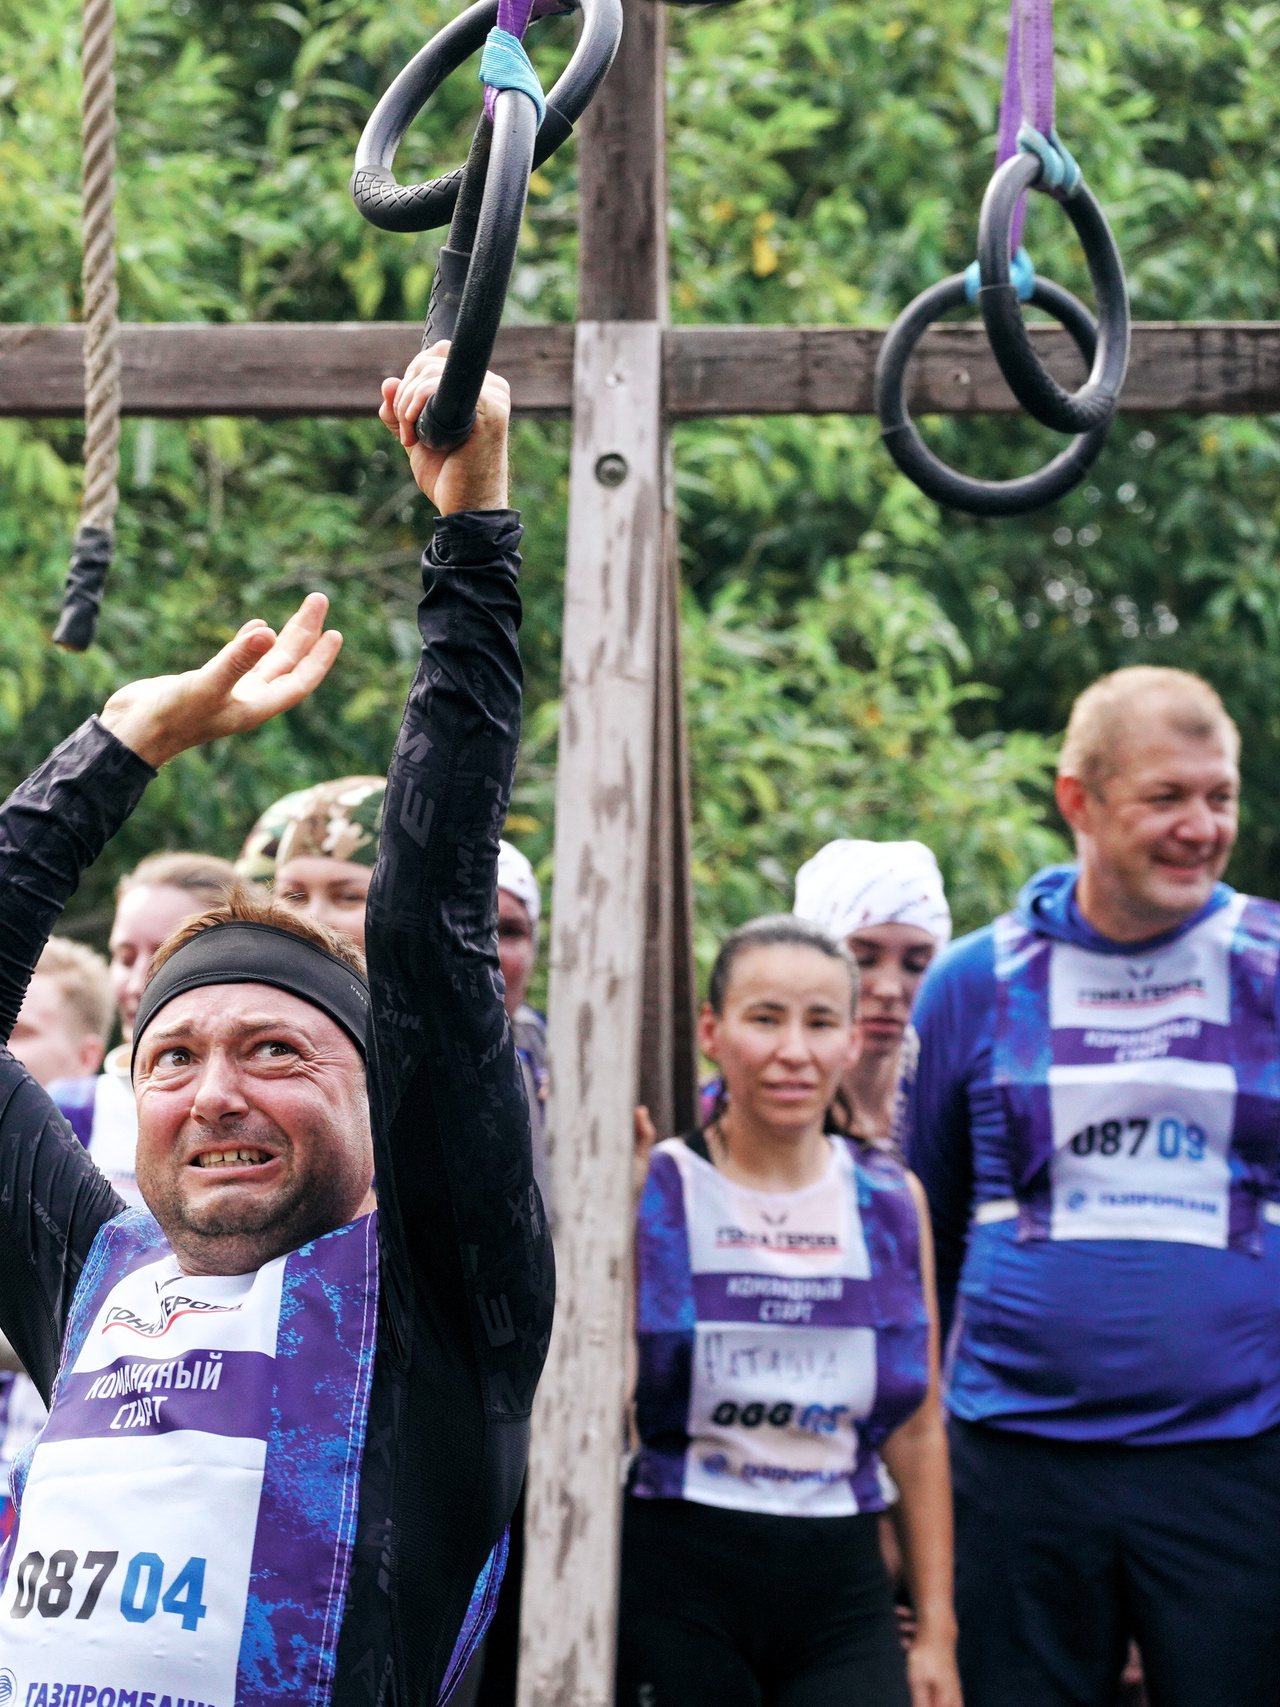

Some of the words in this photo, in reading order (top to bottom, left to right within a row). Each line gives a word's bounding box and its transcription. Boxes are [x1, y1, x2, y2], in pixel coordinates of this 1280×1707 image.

[84, 1352, 223, 1401] КОМАНДНЫЙ
[109, 1396, 169, 1430] СТАРТ
[9, 1549, 207, 1632] 08704
